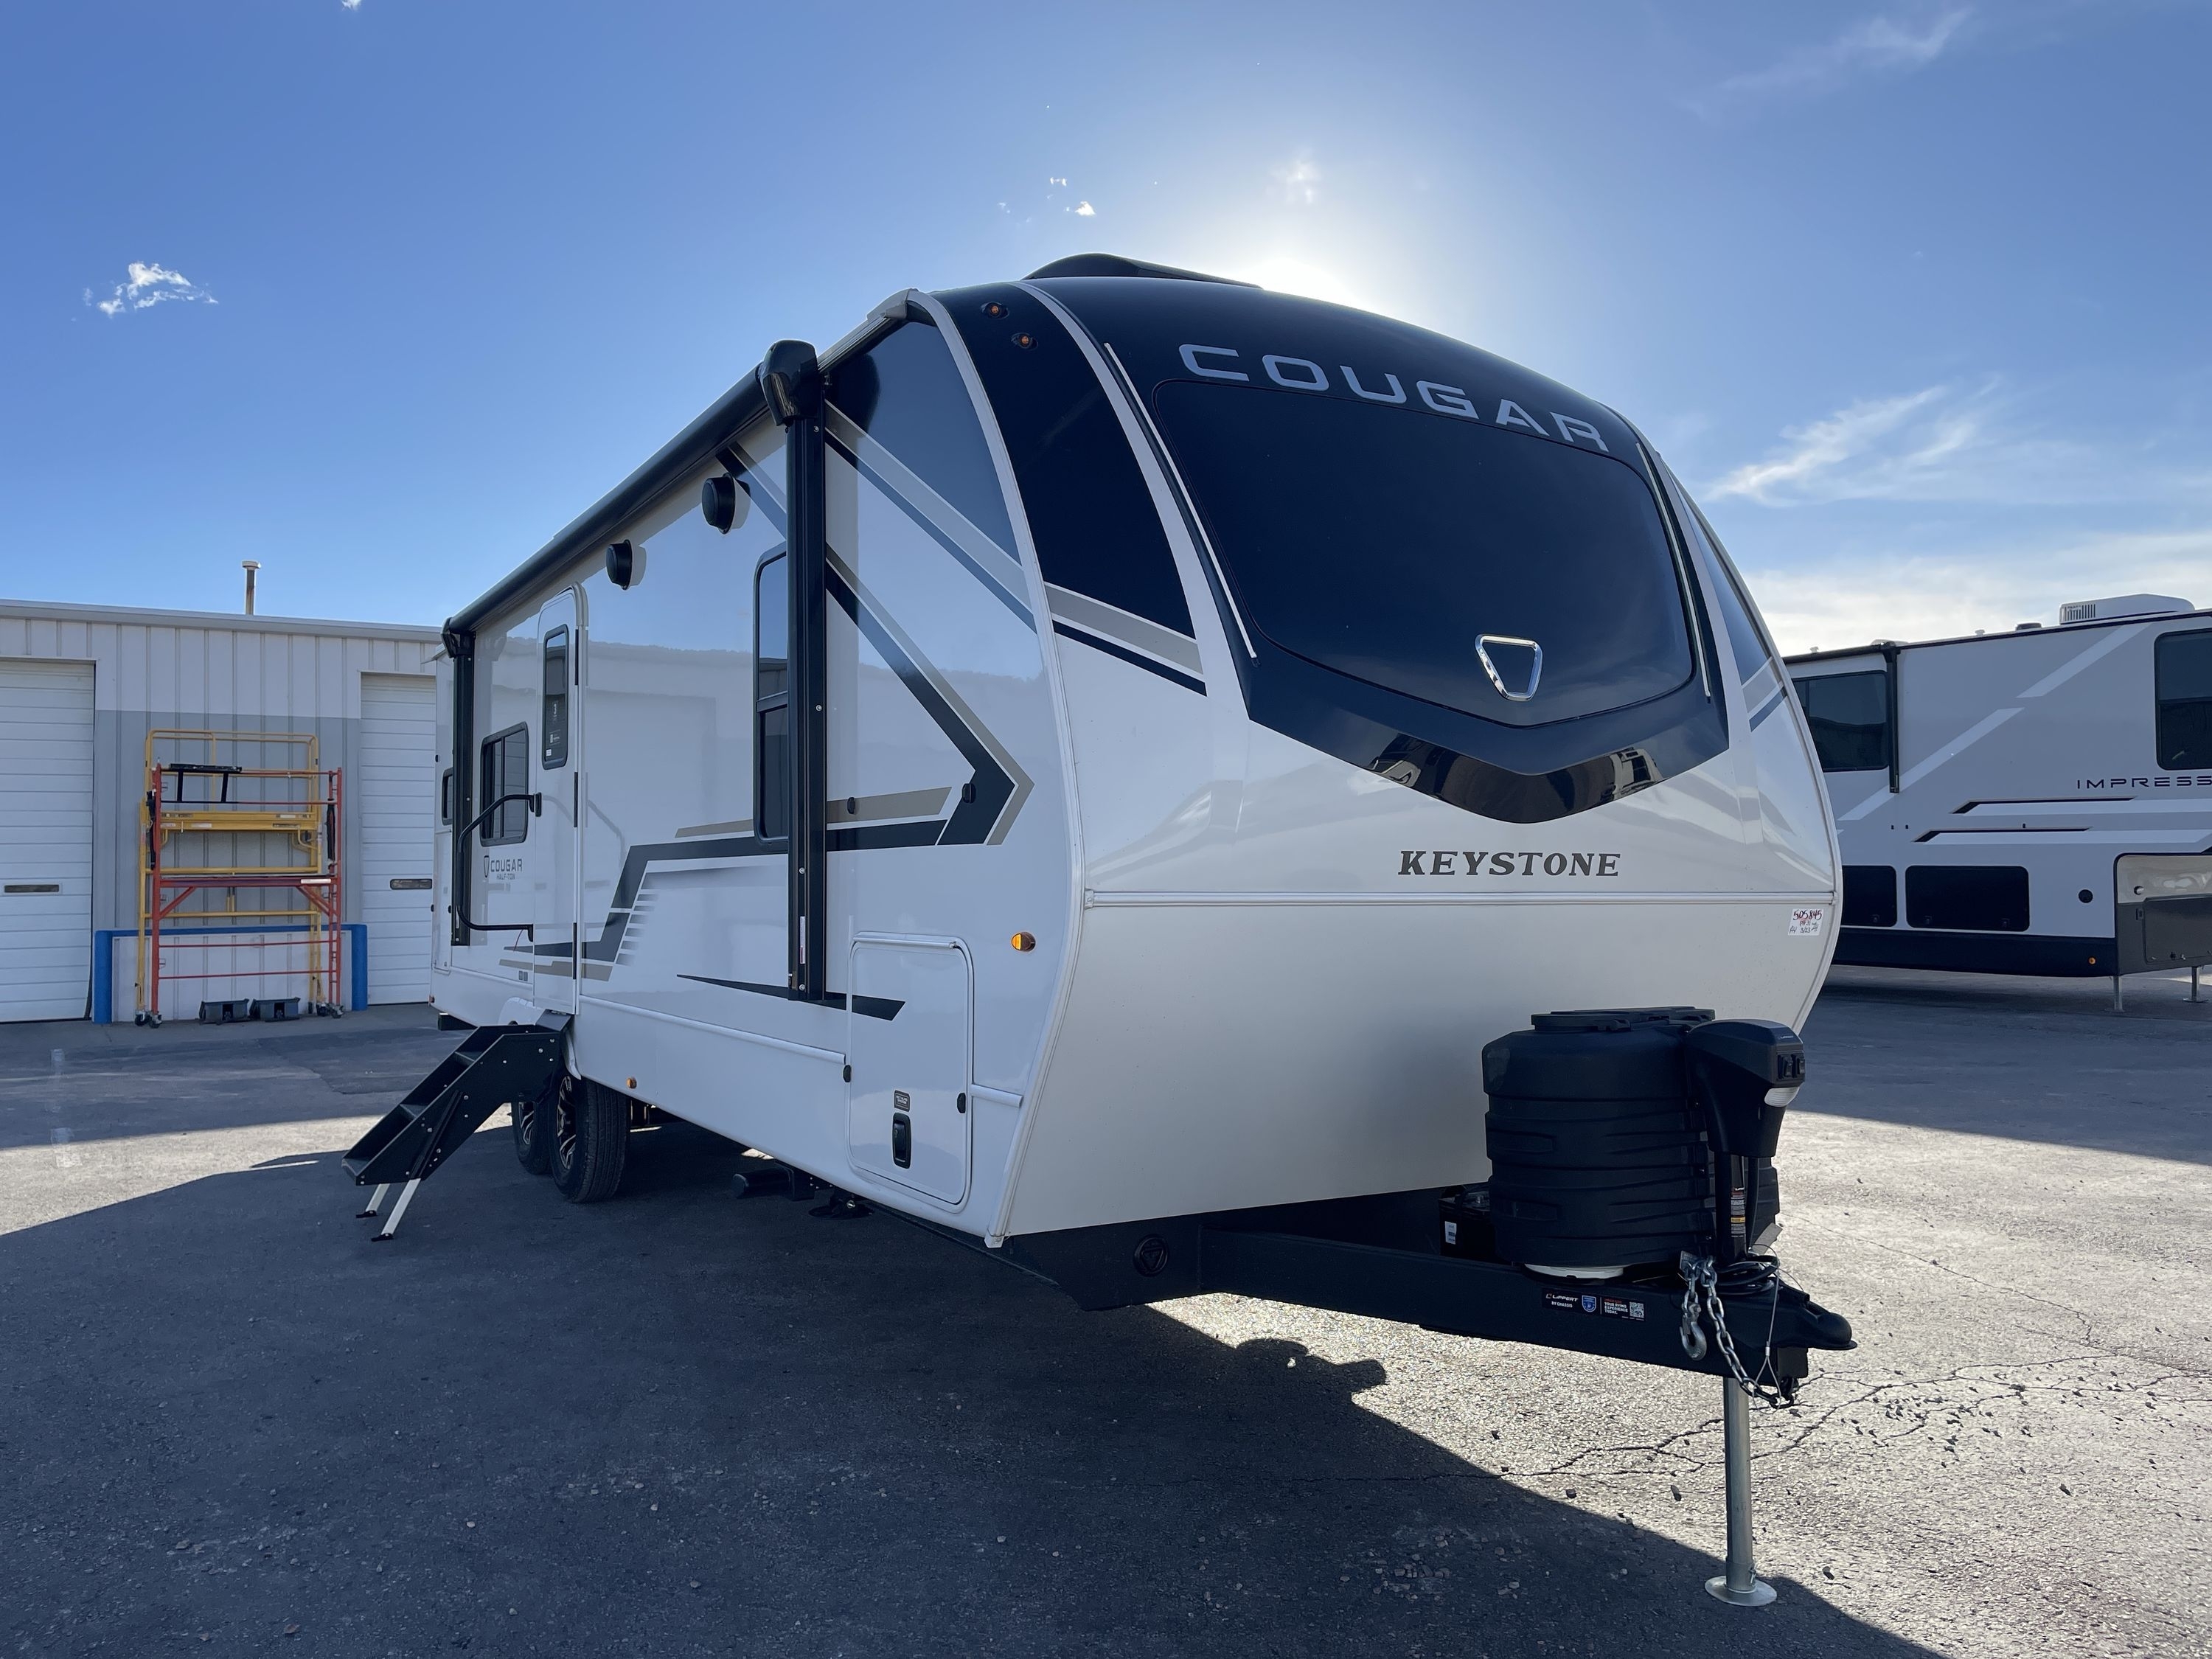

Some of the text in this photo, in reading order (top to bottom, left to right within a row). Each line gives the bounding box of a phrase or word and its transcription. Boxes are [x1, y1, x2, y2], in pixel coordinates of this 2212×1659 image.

[1178, 344, 1610, 453] COUGAR
[2077, 775, 2212, 789] IMPRESS
[490, 858, 523, 872] COUGAR
[1397, 850, 1621, 876] KEYSTONE
[1792, 909, 1823, 921] 505845
